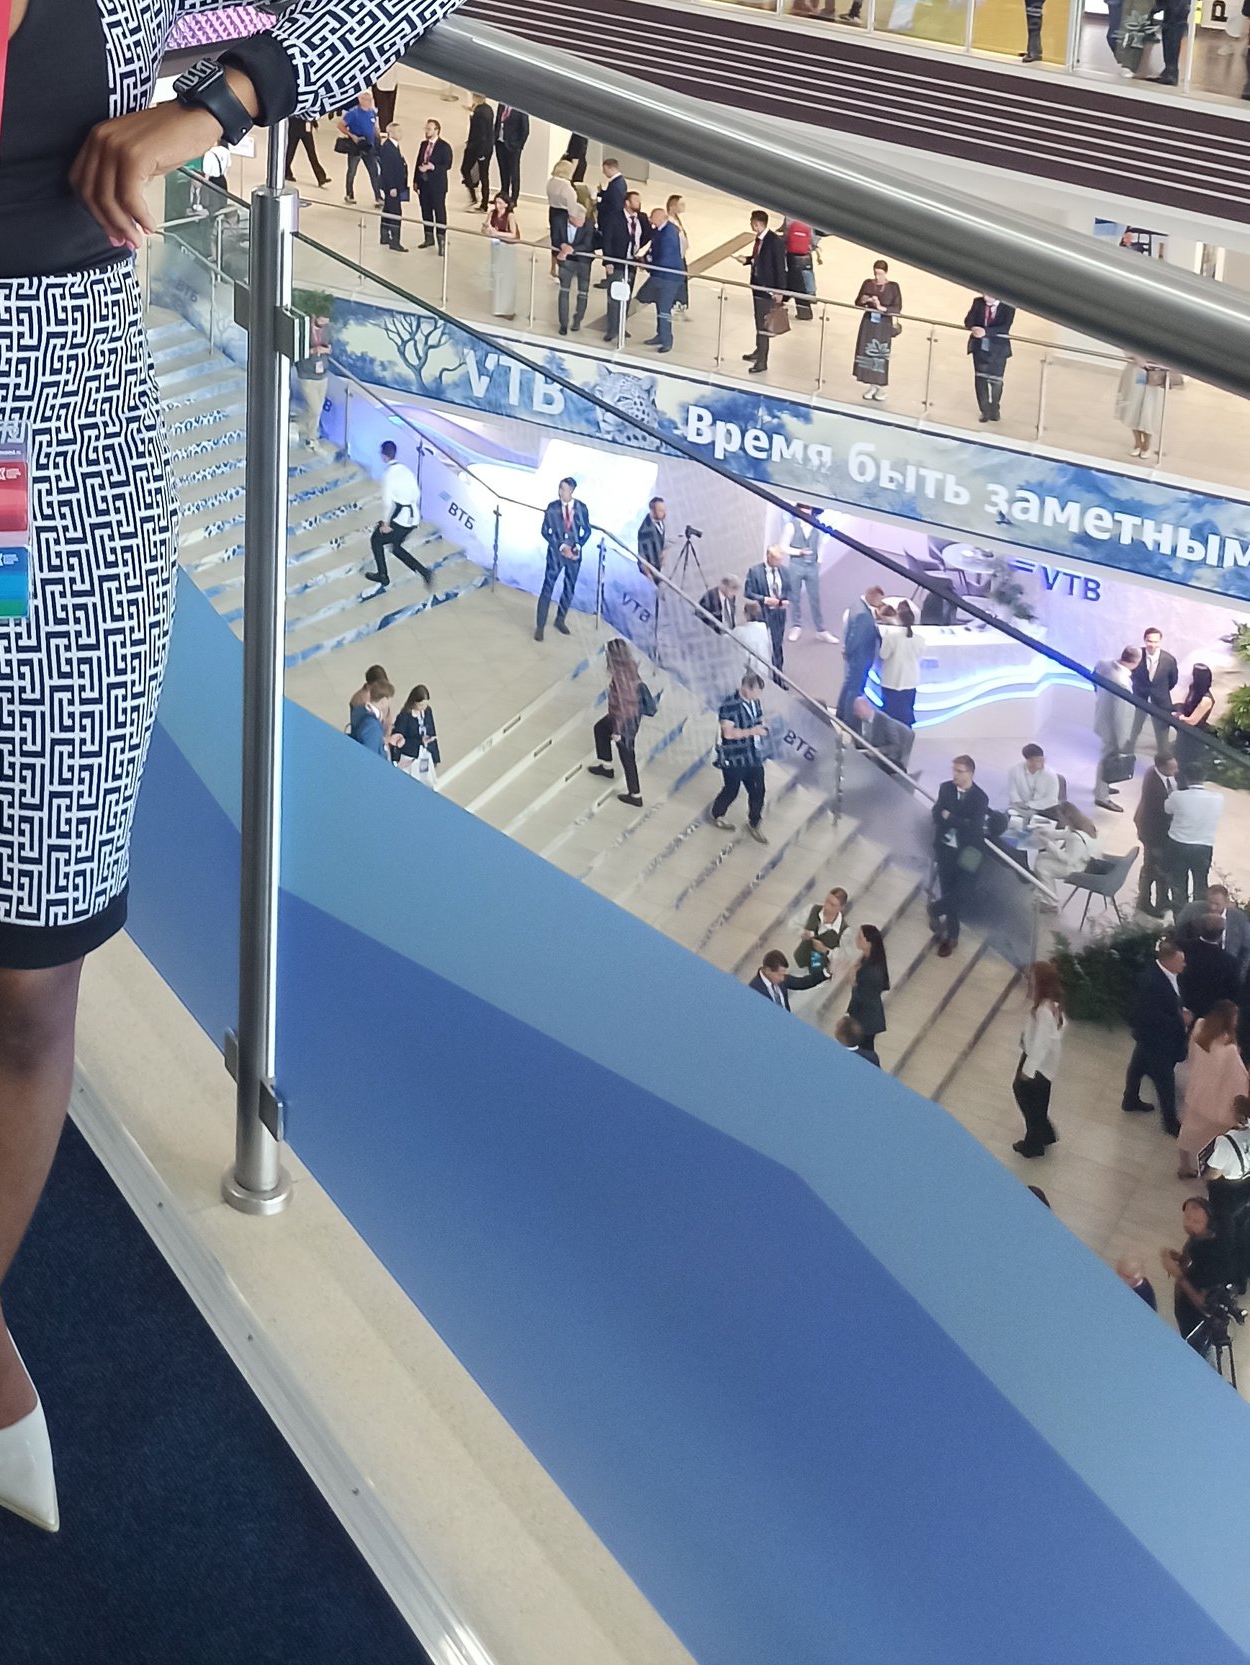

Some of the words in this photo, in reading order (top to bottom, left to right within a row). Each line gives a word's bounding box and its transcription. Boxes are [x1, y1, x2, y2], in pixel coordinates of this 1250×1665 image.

[686, 404, 833, 474] Время
[848, 441, 971, 506] быть
[448, 501, 477, 531] ВТБ
[1042, 565, 1102, 603] VTB
[622, 592, 651, 624] VTB
[782, 729, 818, 763] ВТБ
